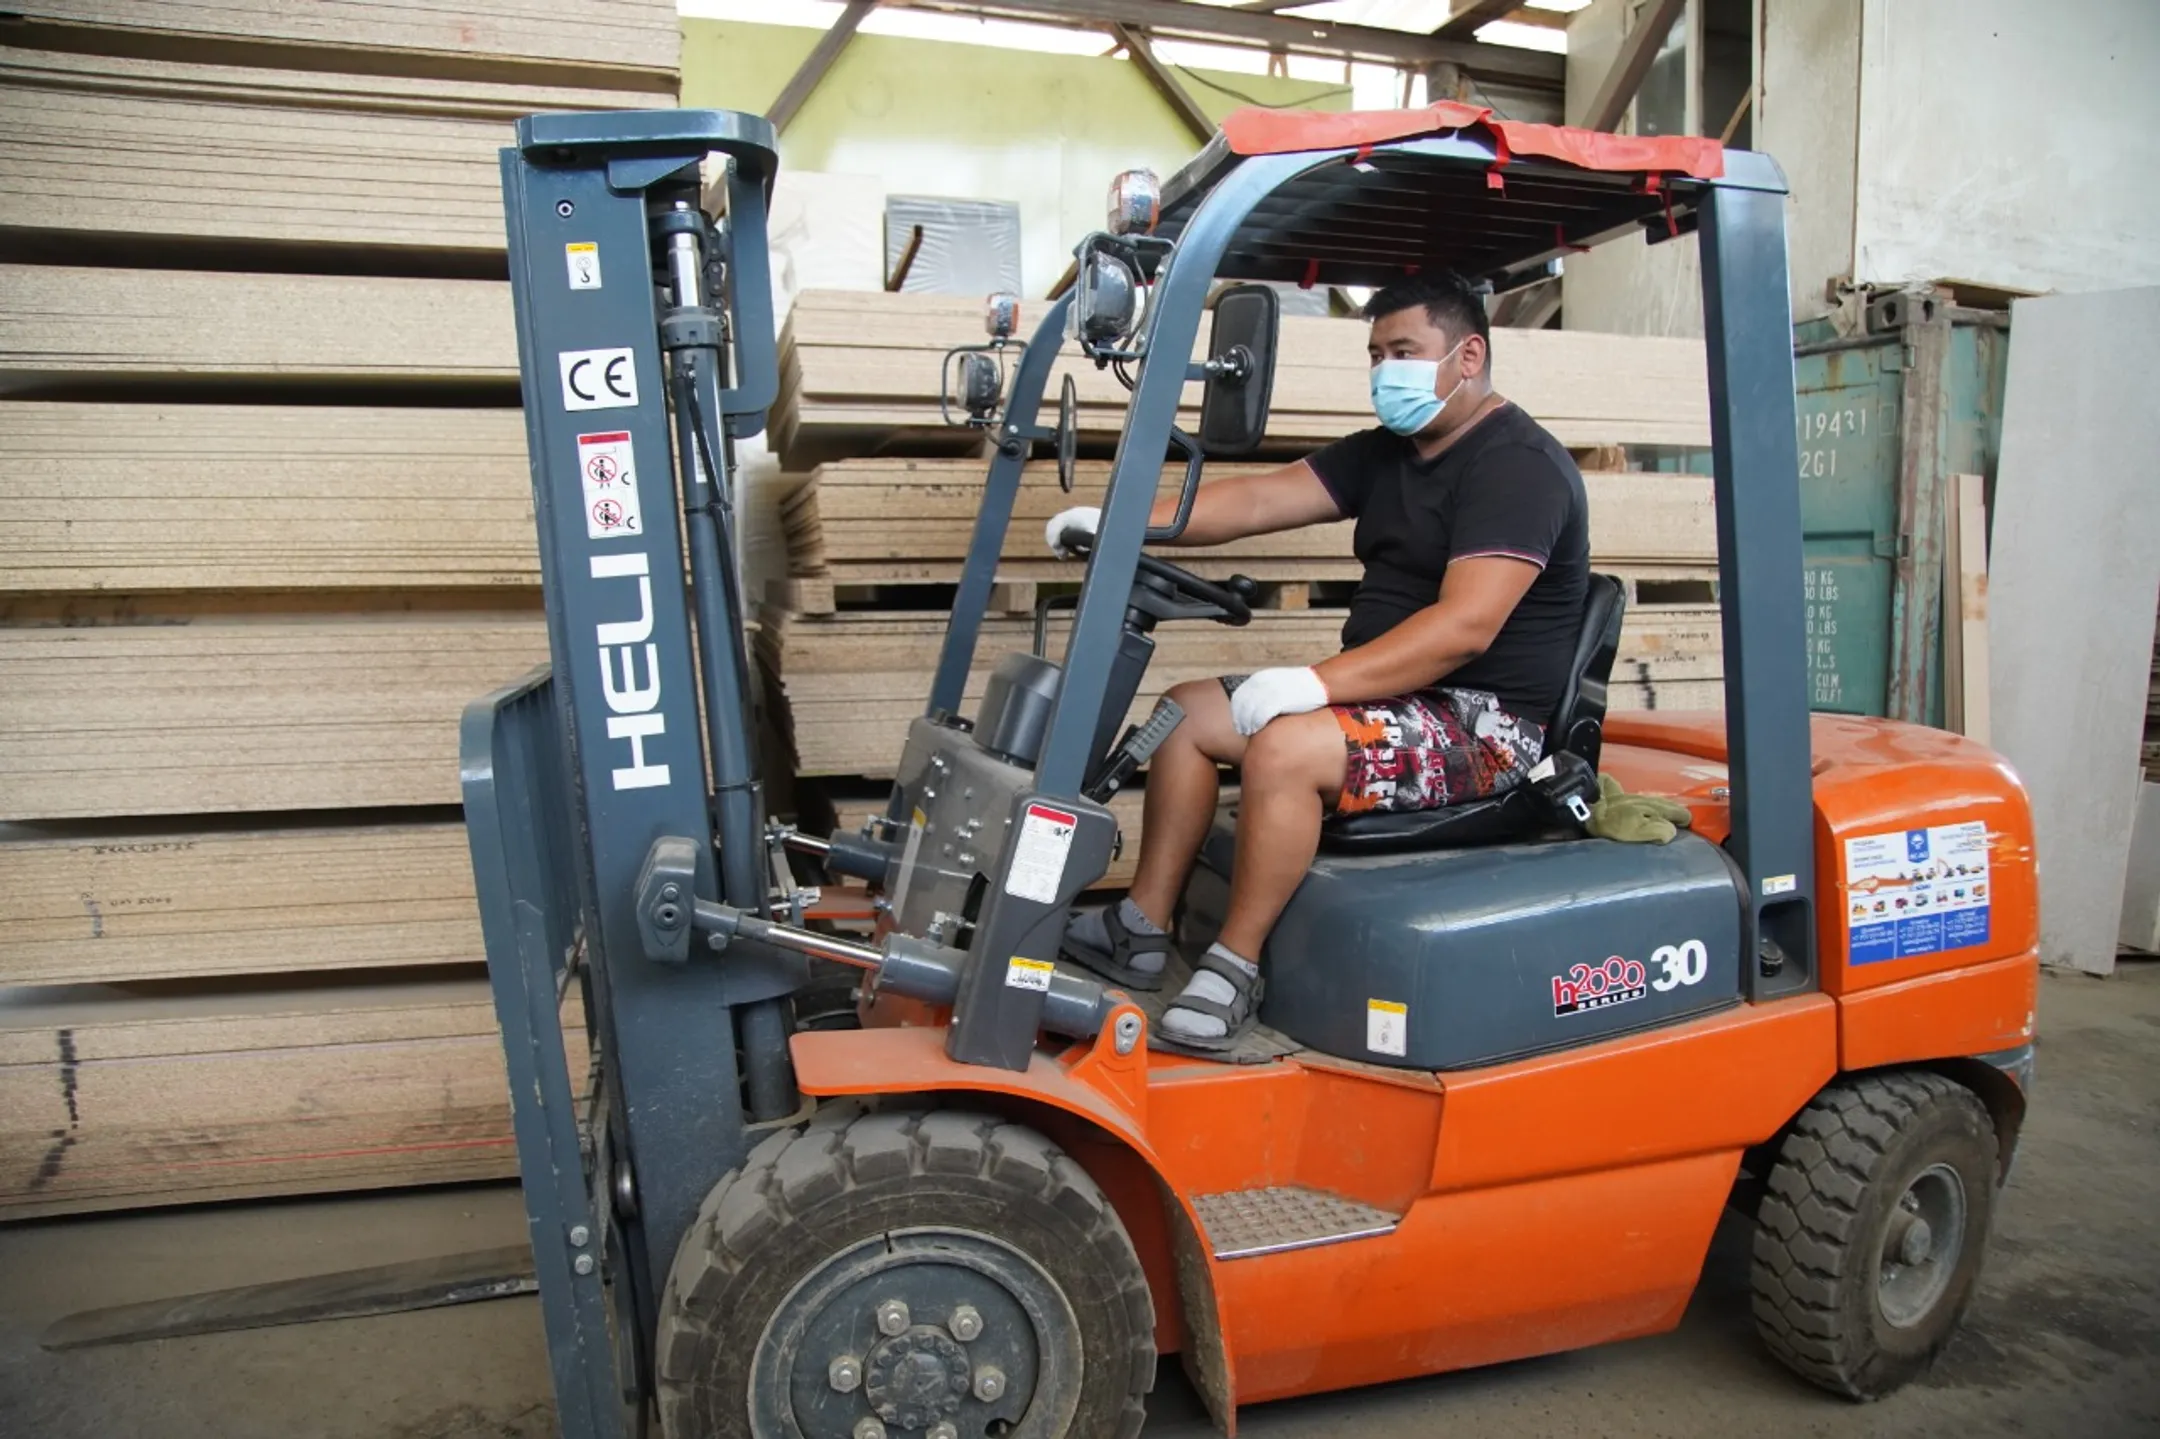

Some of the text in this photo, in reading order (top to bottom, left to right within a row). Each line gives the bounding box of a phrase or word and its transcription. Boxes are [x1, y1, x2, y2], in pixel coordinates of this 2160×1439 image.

[569, 356, 631, 401] CE
[1820, 570, 1834, 585] KG
[1820, 586, 1839, 601] LBS
[1819, 604, 1832, 619] KG
[1818, 620, 1838, 635] LBS
[1817, 639, 1831, 654] KG
[590, 553, 671, 791] HELI
[1650, 939, 1708, 992] 30
